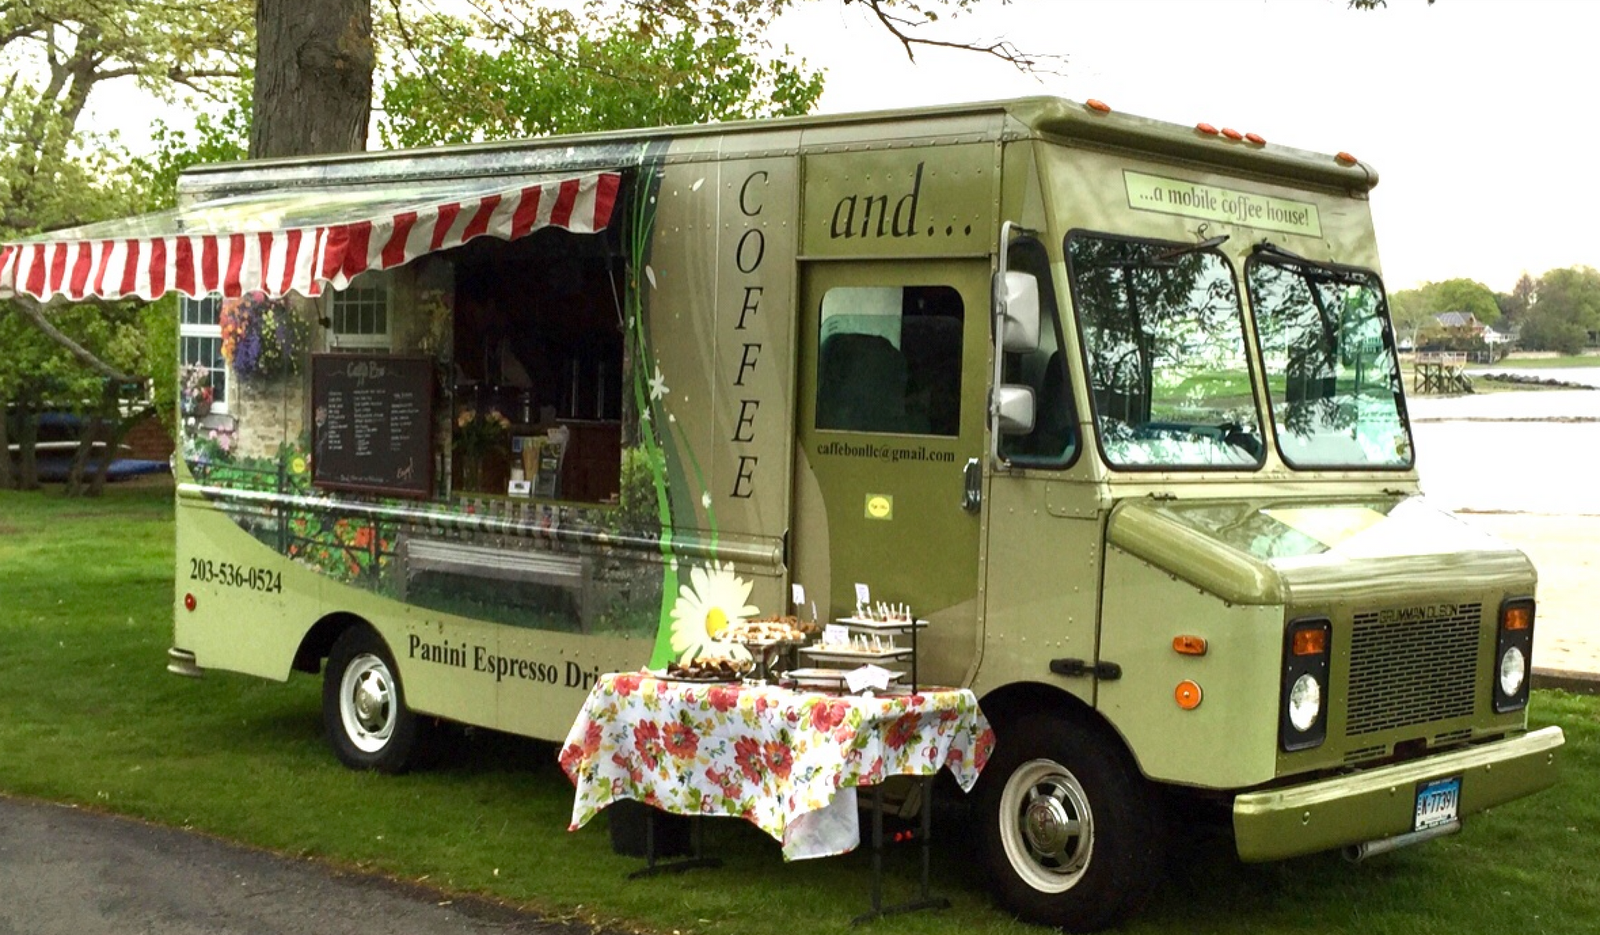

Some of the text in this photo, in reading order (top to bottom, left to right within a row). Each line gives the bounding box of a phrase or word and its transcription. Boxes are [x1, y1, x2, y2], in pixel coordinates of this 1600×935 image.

[830, 161, 972, 240] and...
[1168, 187, 1217, 212] mobile
[1221, 195, 1263, 222] coffee
[1266, 200, 1309, 227] house!
[730, 170, 768, 499] COFFEE
[817, 441, 956, 463] caffebonllc@gmail.com
[190, 557, 283, 595] 203-536-0524
[408, 634, 467, 669] Panini
[473, 646, 559, 686] Espresso
